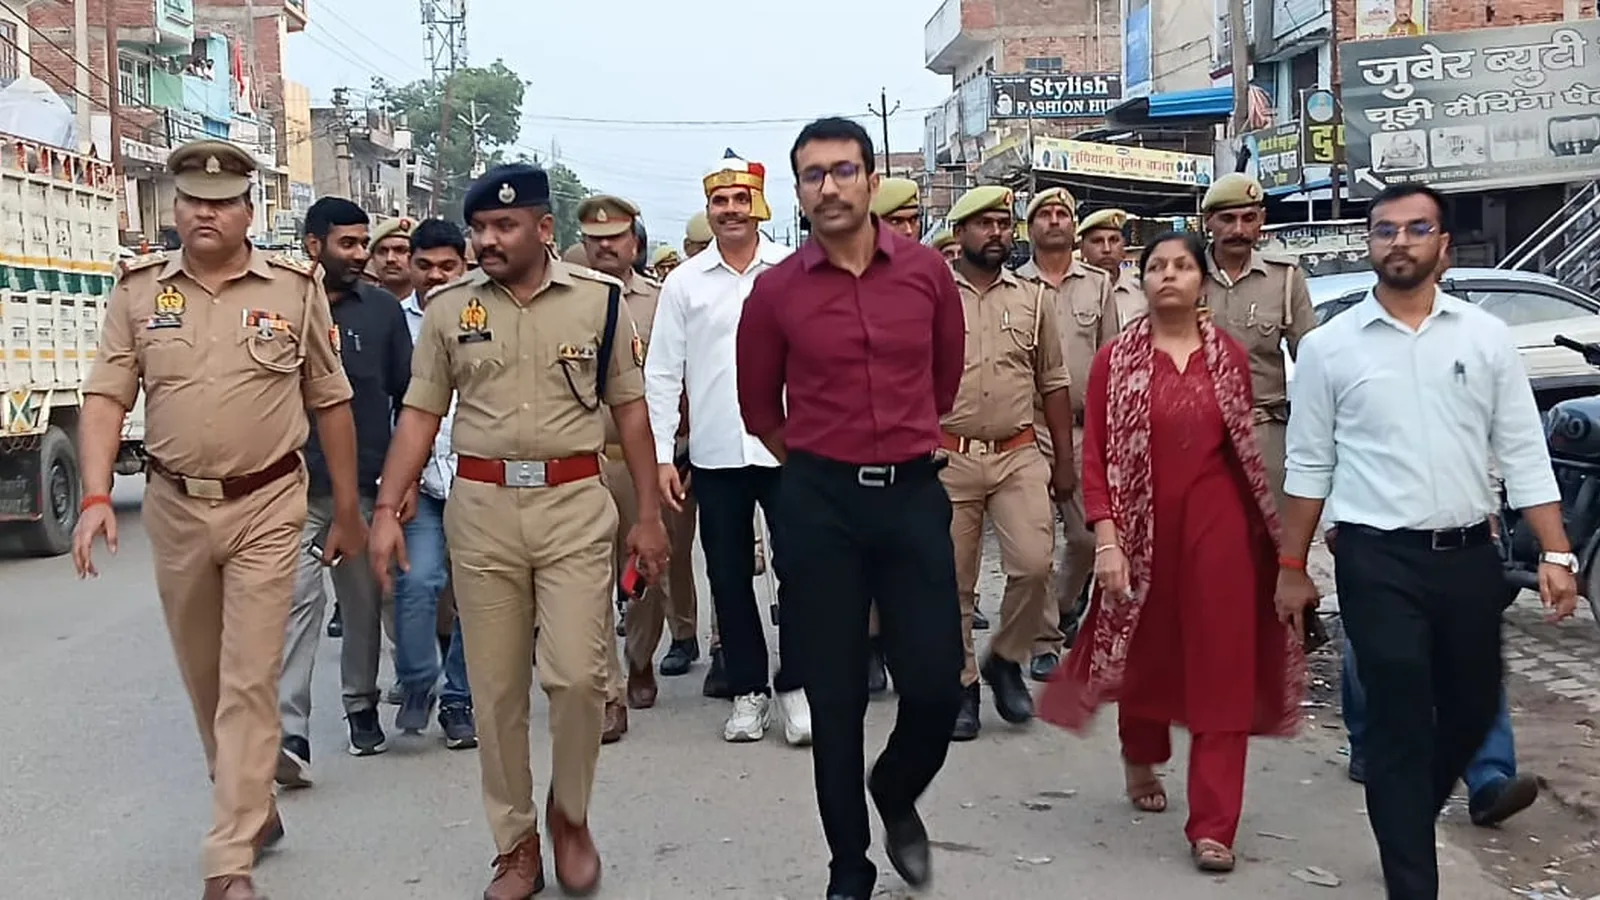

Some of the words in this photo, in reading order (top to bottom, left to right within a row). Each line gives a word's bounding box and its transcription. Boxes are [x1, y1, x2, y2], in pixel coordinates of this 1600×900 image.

[1357, 42, 1476, 100] जुबेर
[1482, 28, 1588, 88] ब्युटी
[1029, 76, 1109, 99] Stylish
[1016, 100, 1084, 115] FASHION
